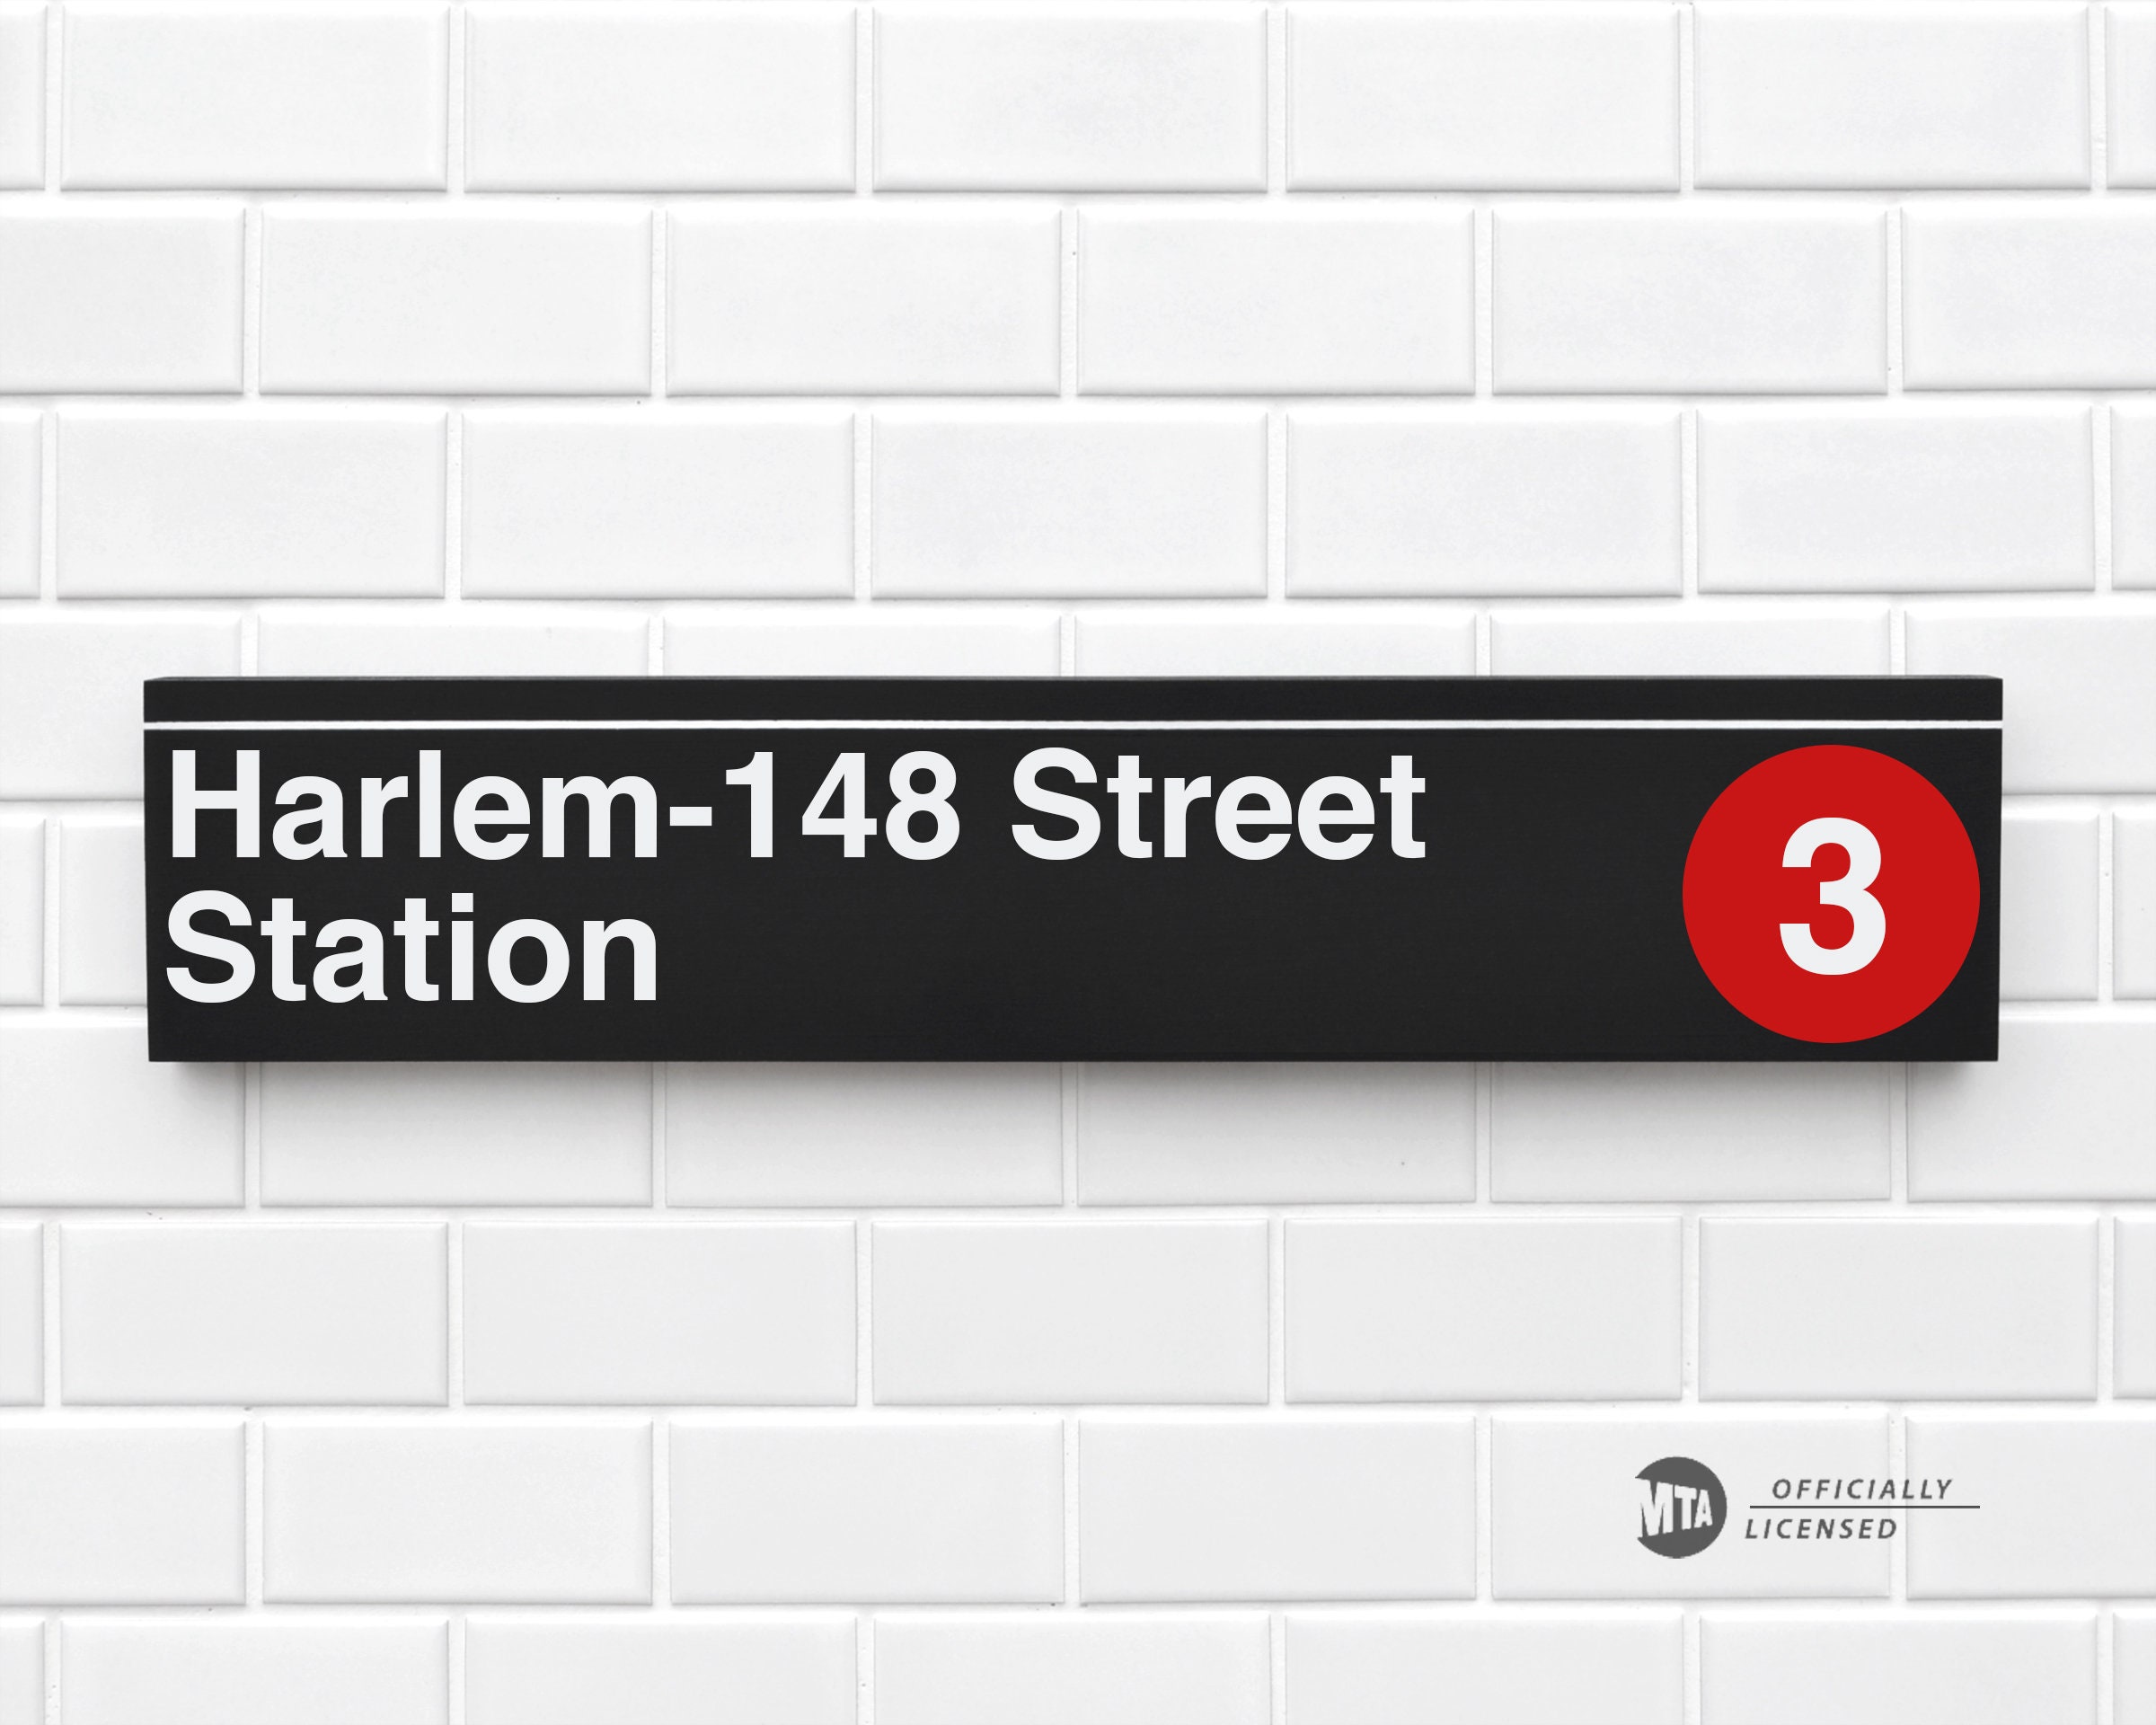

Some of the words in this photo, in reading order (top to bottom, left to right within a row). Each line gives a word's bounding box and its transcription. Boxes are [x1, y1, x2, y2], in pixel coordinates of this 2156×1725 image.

[167, 748, 960, 861] Harlem-148
[1012, 747, 1426, 861] Street
[166, 889, 657, 1004] Station
[1779, 817, 1886, 976] 3
